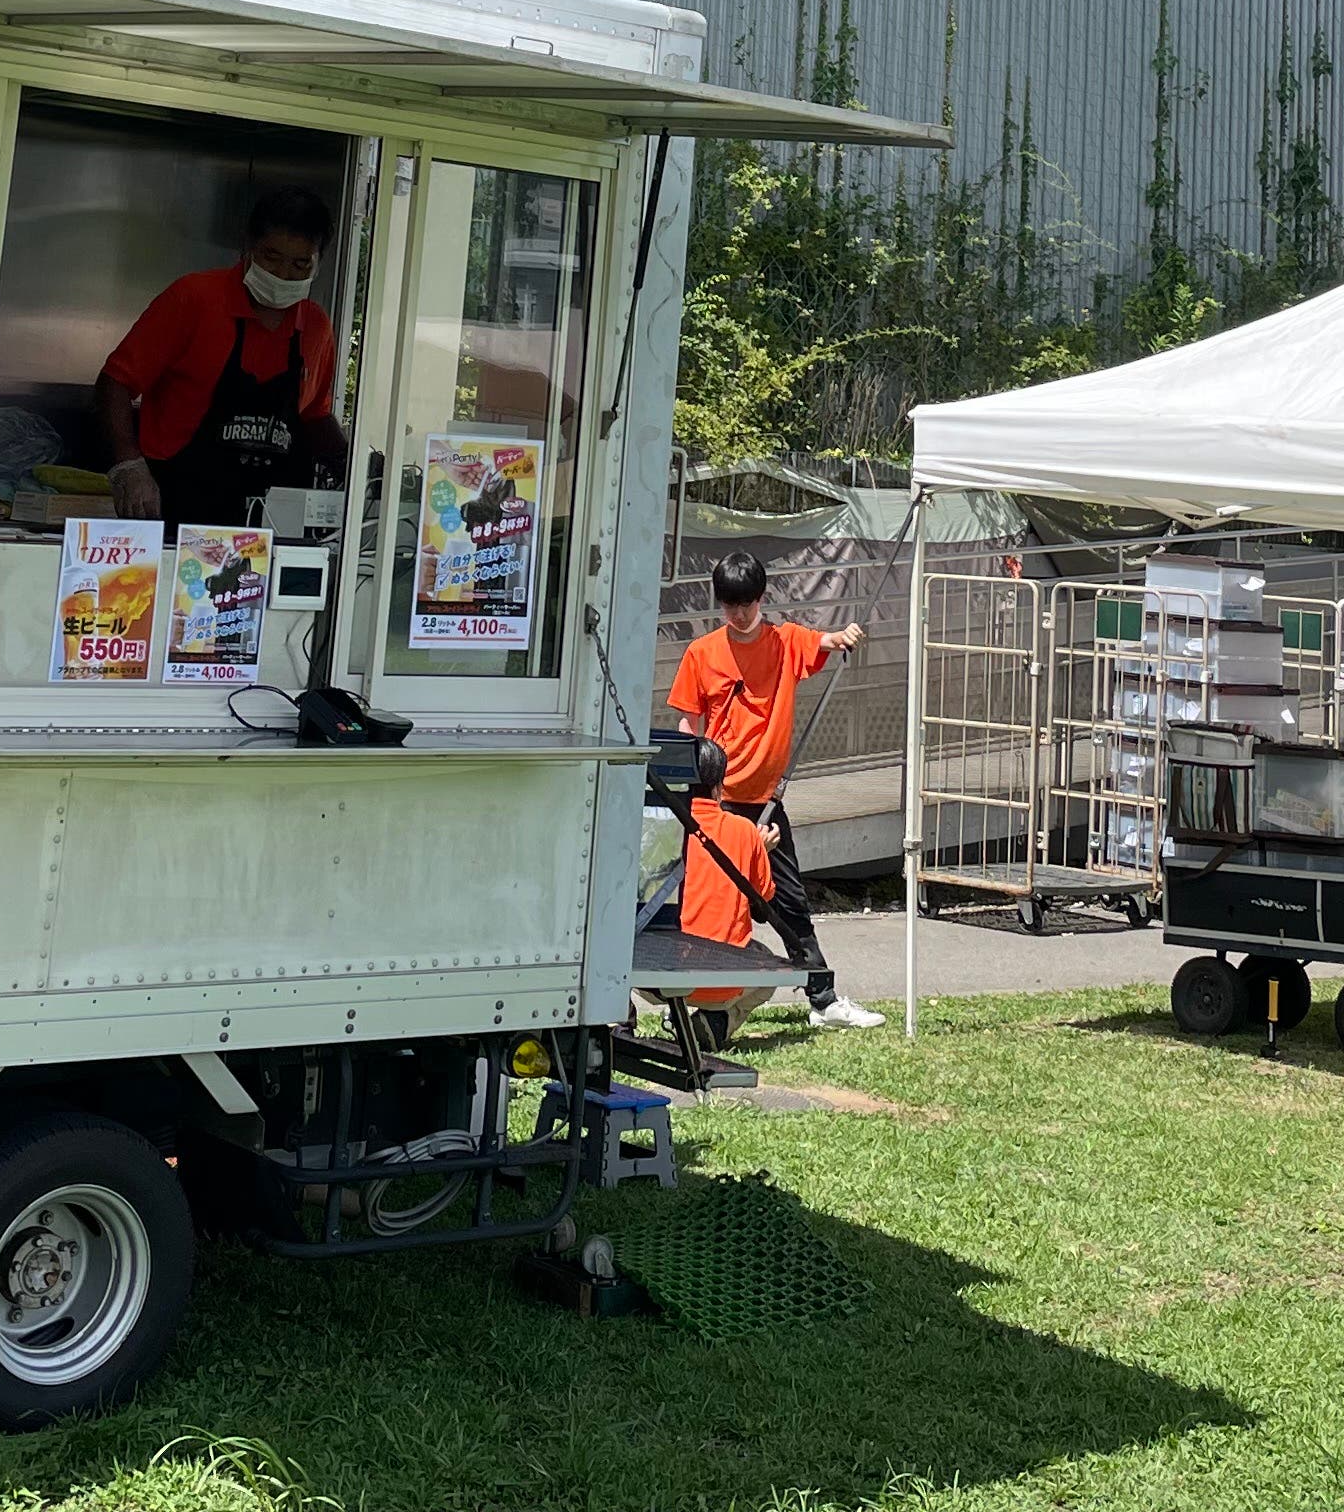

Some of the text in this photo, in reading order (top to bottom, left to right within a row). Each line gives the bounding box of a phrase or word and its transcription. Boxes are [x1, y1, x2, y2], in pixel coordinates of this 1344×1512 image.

[223, 424, 267, 441] URBAN
[63, 616, 127, 636] 生ビール
[80, 637, 138, 661] 550円
